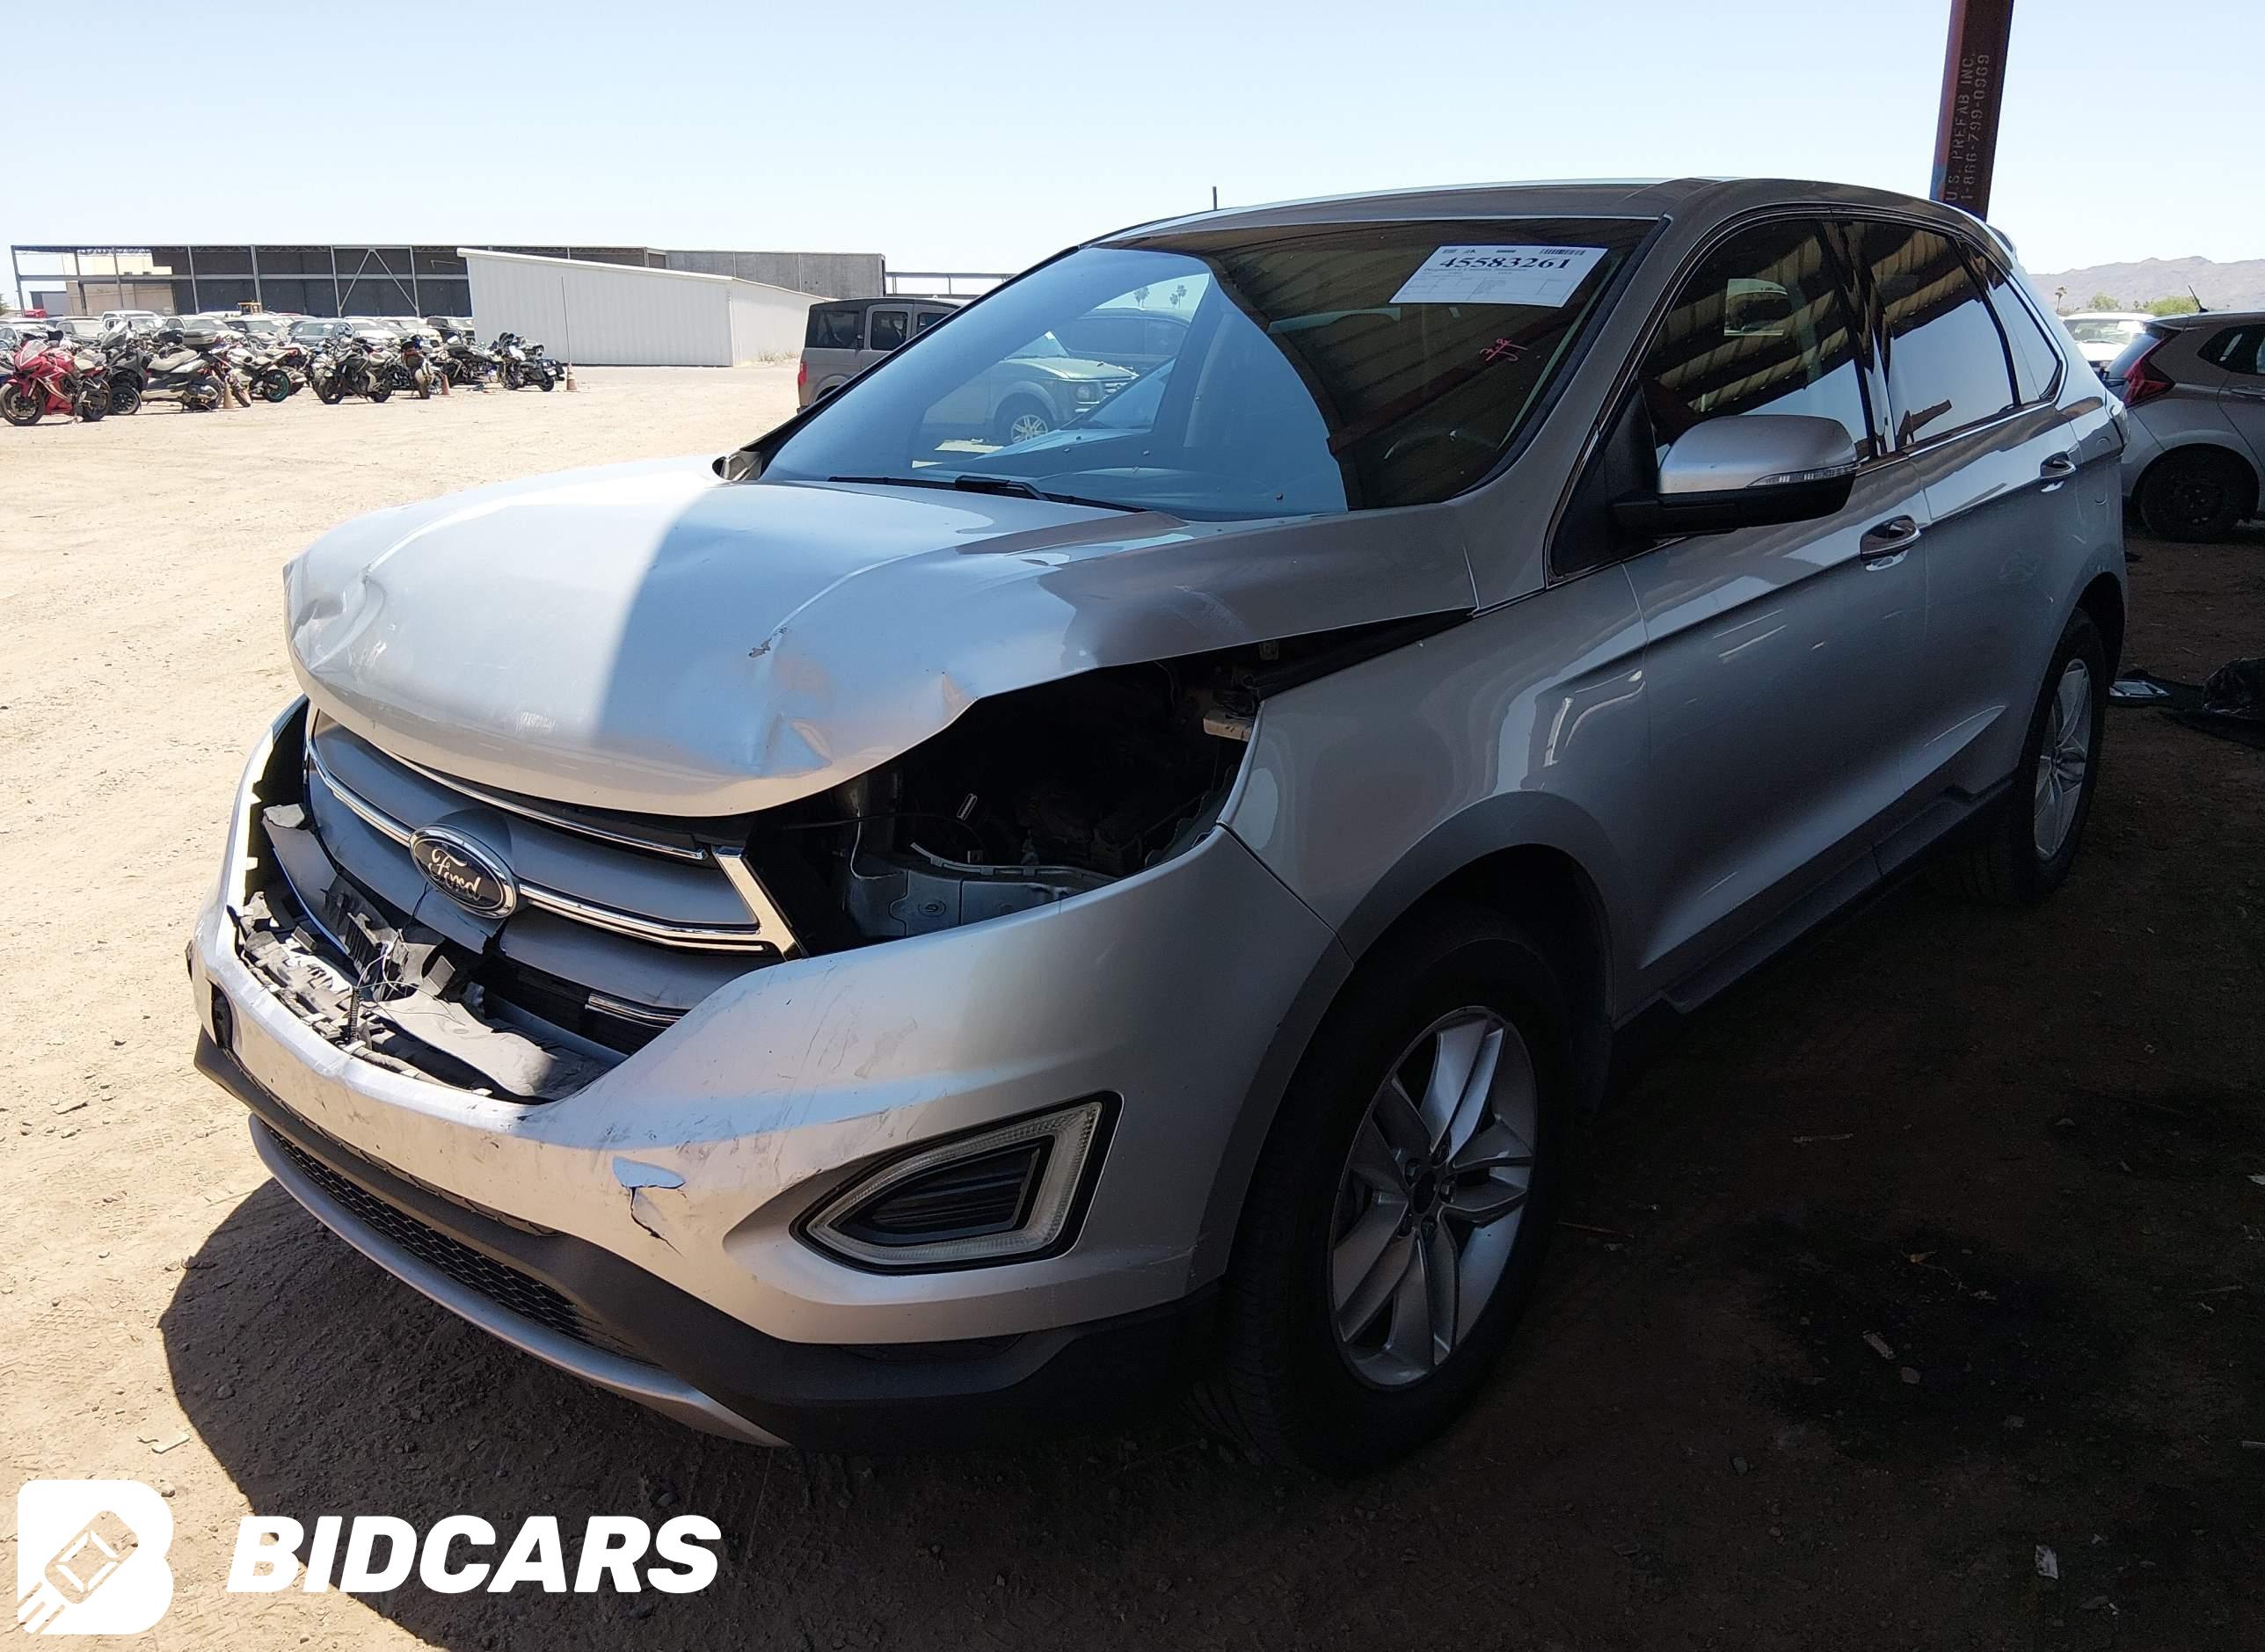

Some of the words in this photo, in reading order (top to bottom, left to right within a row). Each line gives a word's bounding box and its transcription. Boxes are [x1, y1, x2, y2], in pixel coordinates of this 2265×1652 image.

[1960, 53, 1975, 84] INC.
[1951, 94, 1970, 160] PREFAB
[1439, 257, 1571, 269] 45583261
[428, 848, 482, 901] Ford
